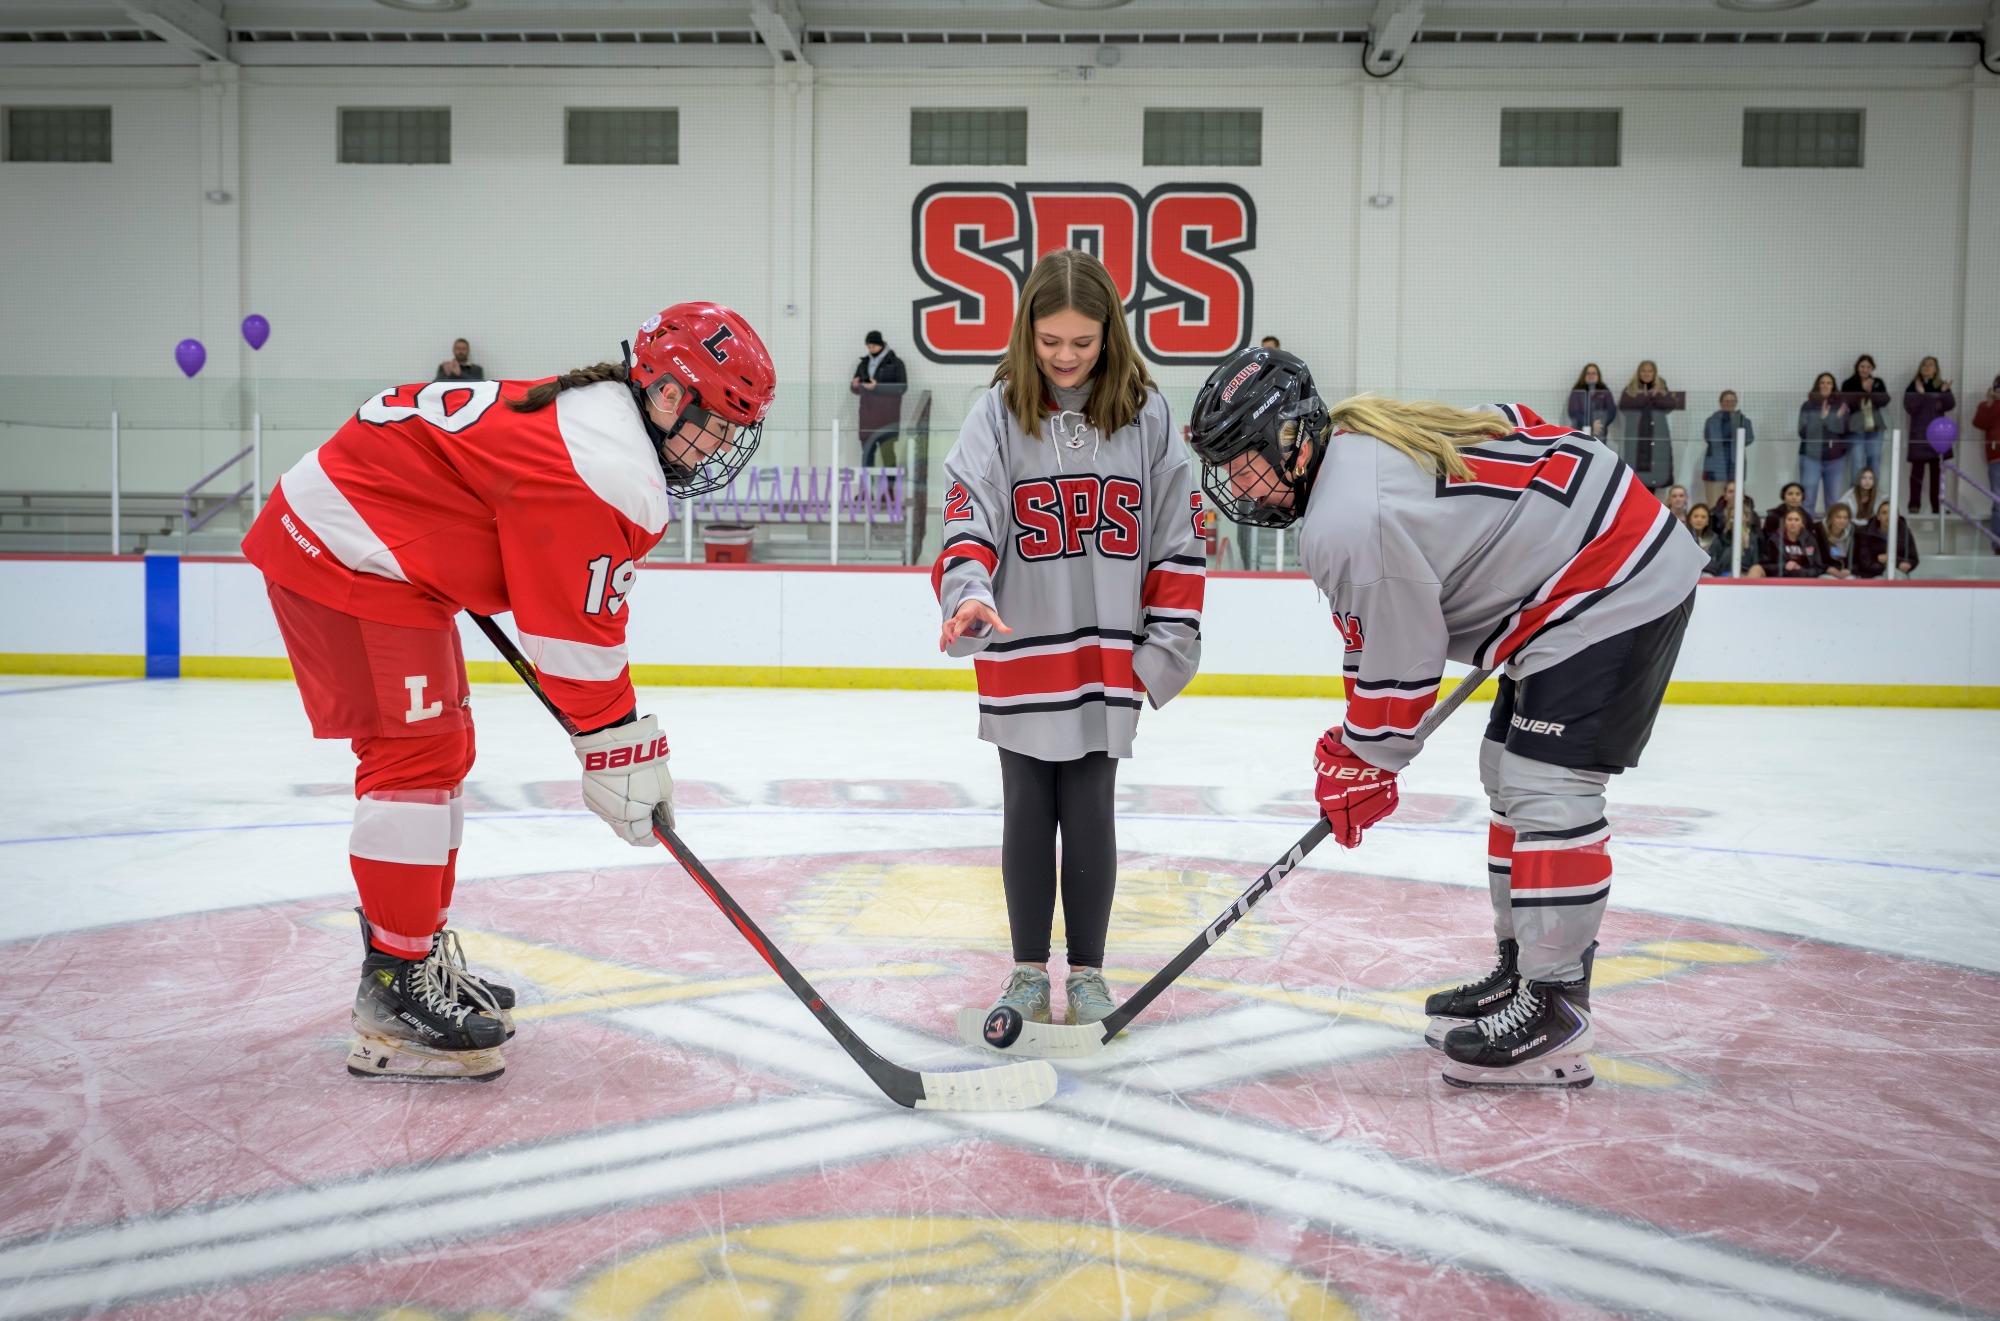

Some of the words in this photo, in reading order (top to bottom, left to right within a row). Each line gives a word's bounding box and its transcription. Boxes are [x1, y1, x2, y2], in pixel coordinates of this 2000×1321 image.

[912, 182, 1256, 365] SPS
[672, 356, 700, 383] CCM
[701, 323, 734, 364] L
[945, 481, 973, 526] 2
[1012, 473, 1141, 562] SPS
[584, 554, 636, 616] 19
[405, 675, 442, 723] L
[1206, 844, 1303, 945] CCM
